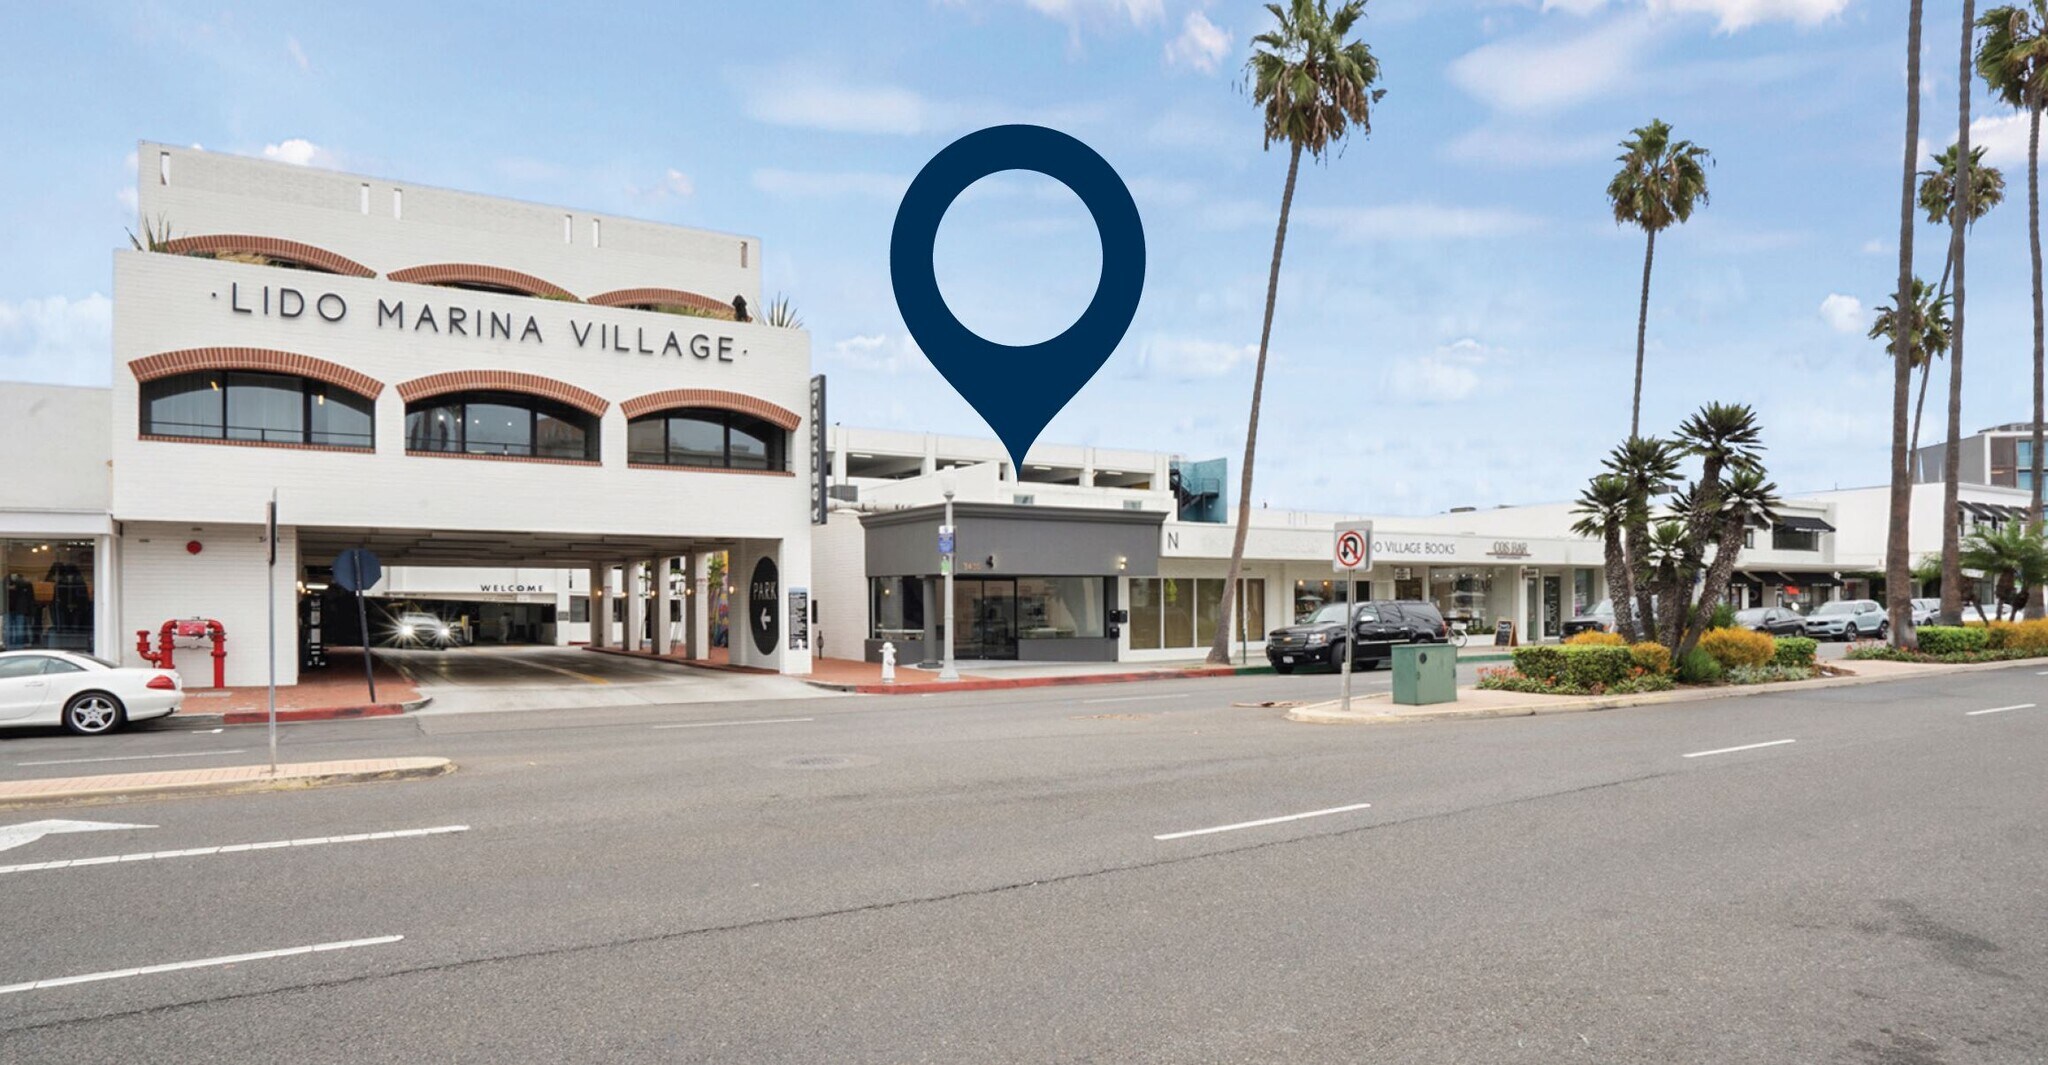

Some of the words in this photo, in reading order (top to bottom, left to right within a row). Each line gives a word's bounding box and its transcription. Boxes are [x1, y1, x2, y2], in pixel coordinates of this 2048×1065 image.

[232, 282, 348, 324] LIDO
[377, 298, 544, 344] MARINA
[570, 320, 735, 364] VILLAGE
[811, 391, 819, 501] PARKING
[1168, 532, 1179, 549] N
[1385, 541, 1421, 554] VILLAGE
[1425, 542, 1455, 555] BOOKS
[1511, 541, 1528, 554] BAR
[480, 584, 544, 592] WELCOME
[753, 581, 777, 600] PARK
